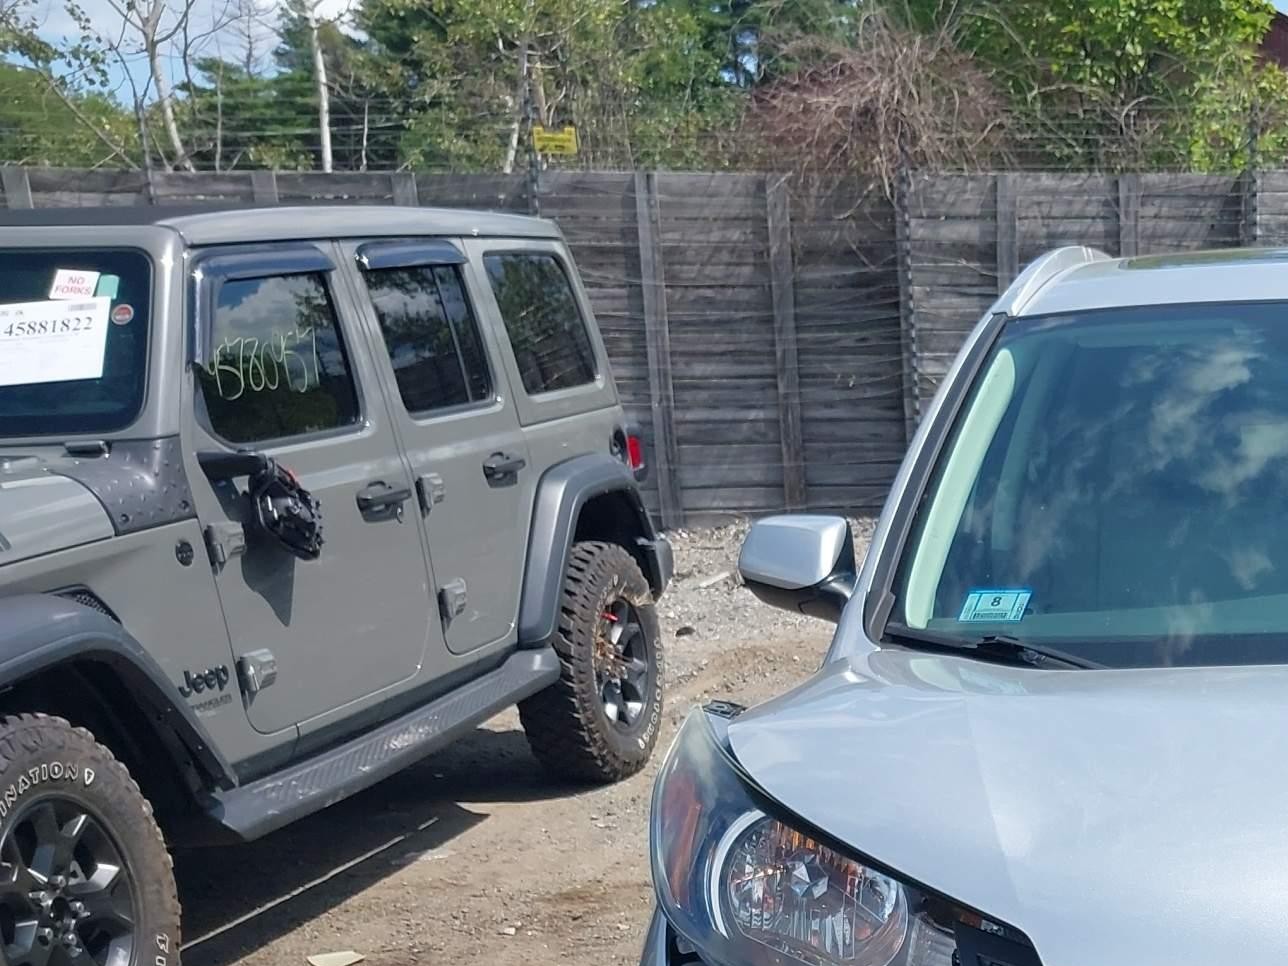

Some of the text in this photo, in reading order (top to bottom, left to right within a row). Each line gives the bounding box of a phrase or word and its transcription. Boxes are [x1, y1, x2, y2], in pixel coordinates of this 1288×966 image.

[67, 276, 85, 285] NO
[54, 285, 91, 296] FORKS
[3, 316, 93, 337] 45881822
[990, 596, 1002, 607] 8
[178, 664, 229, 698] Jeep
